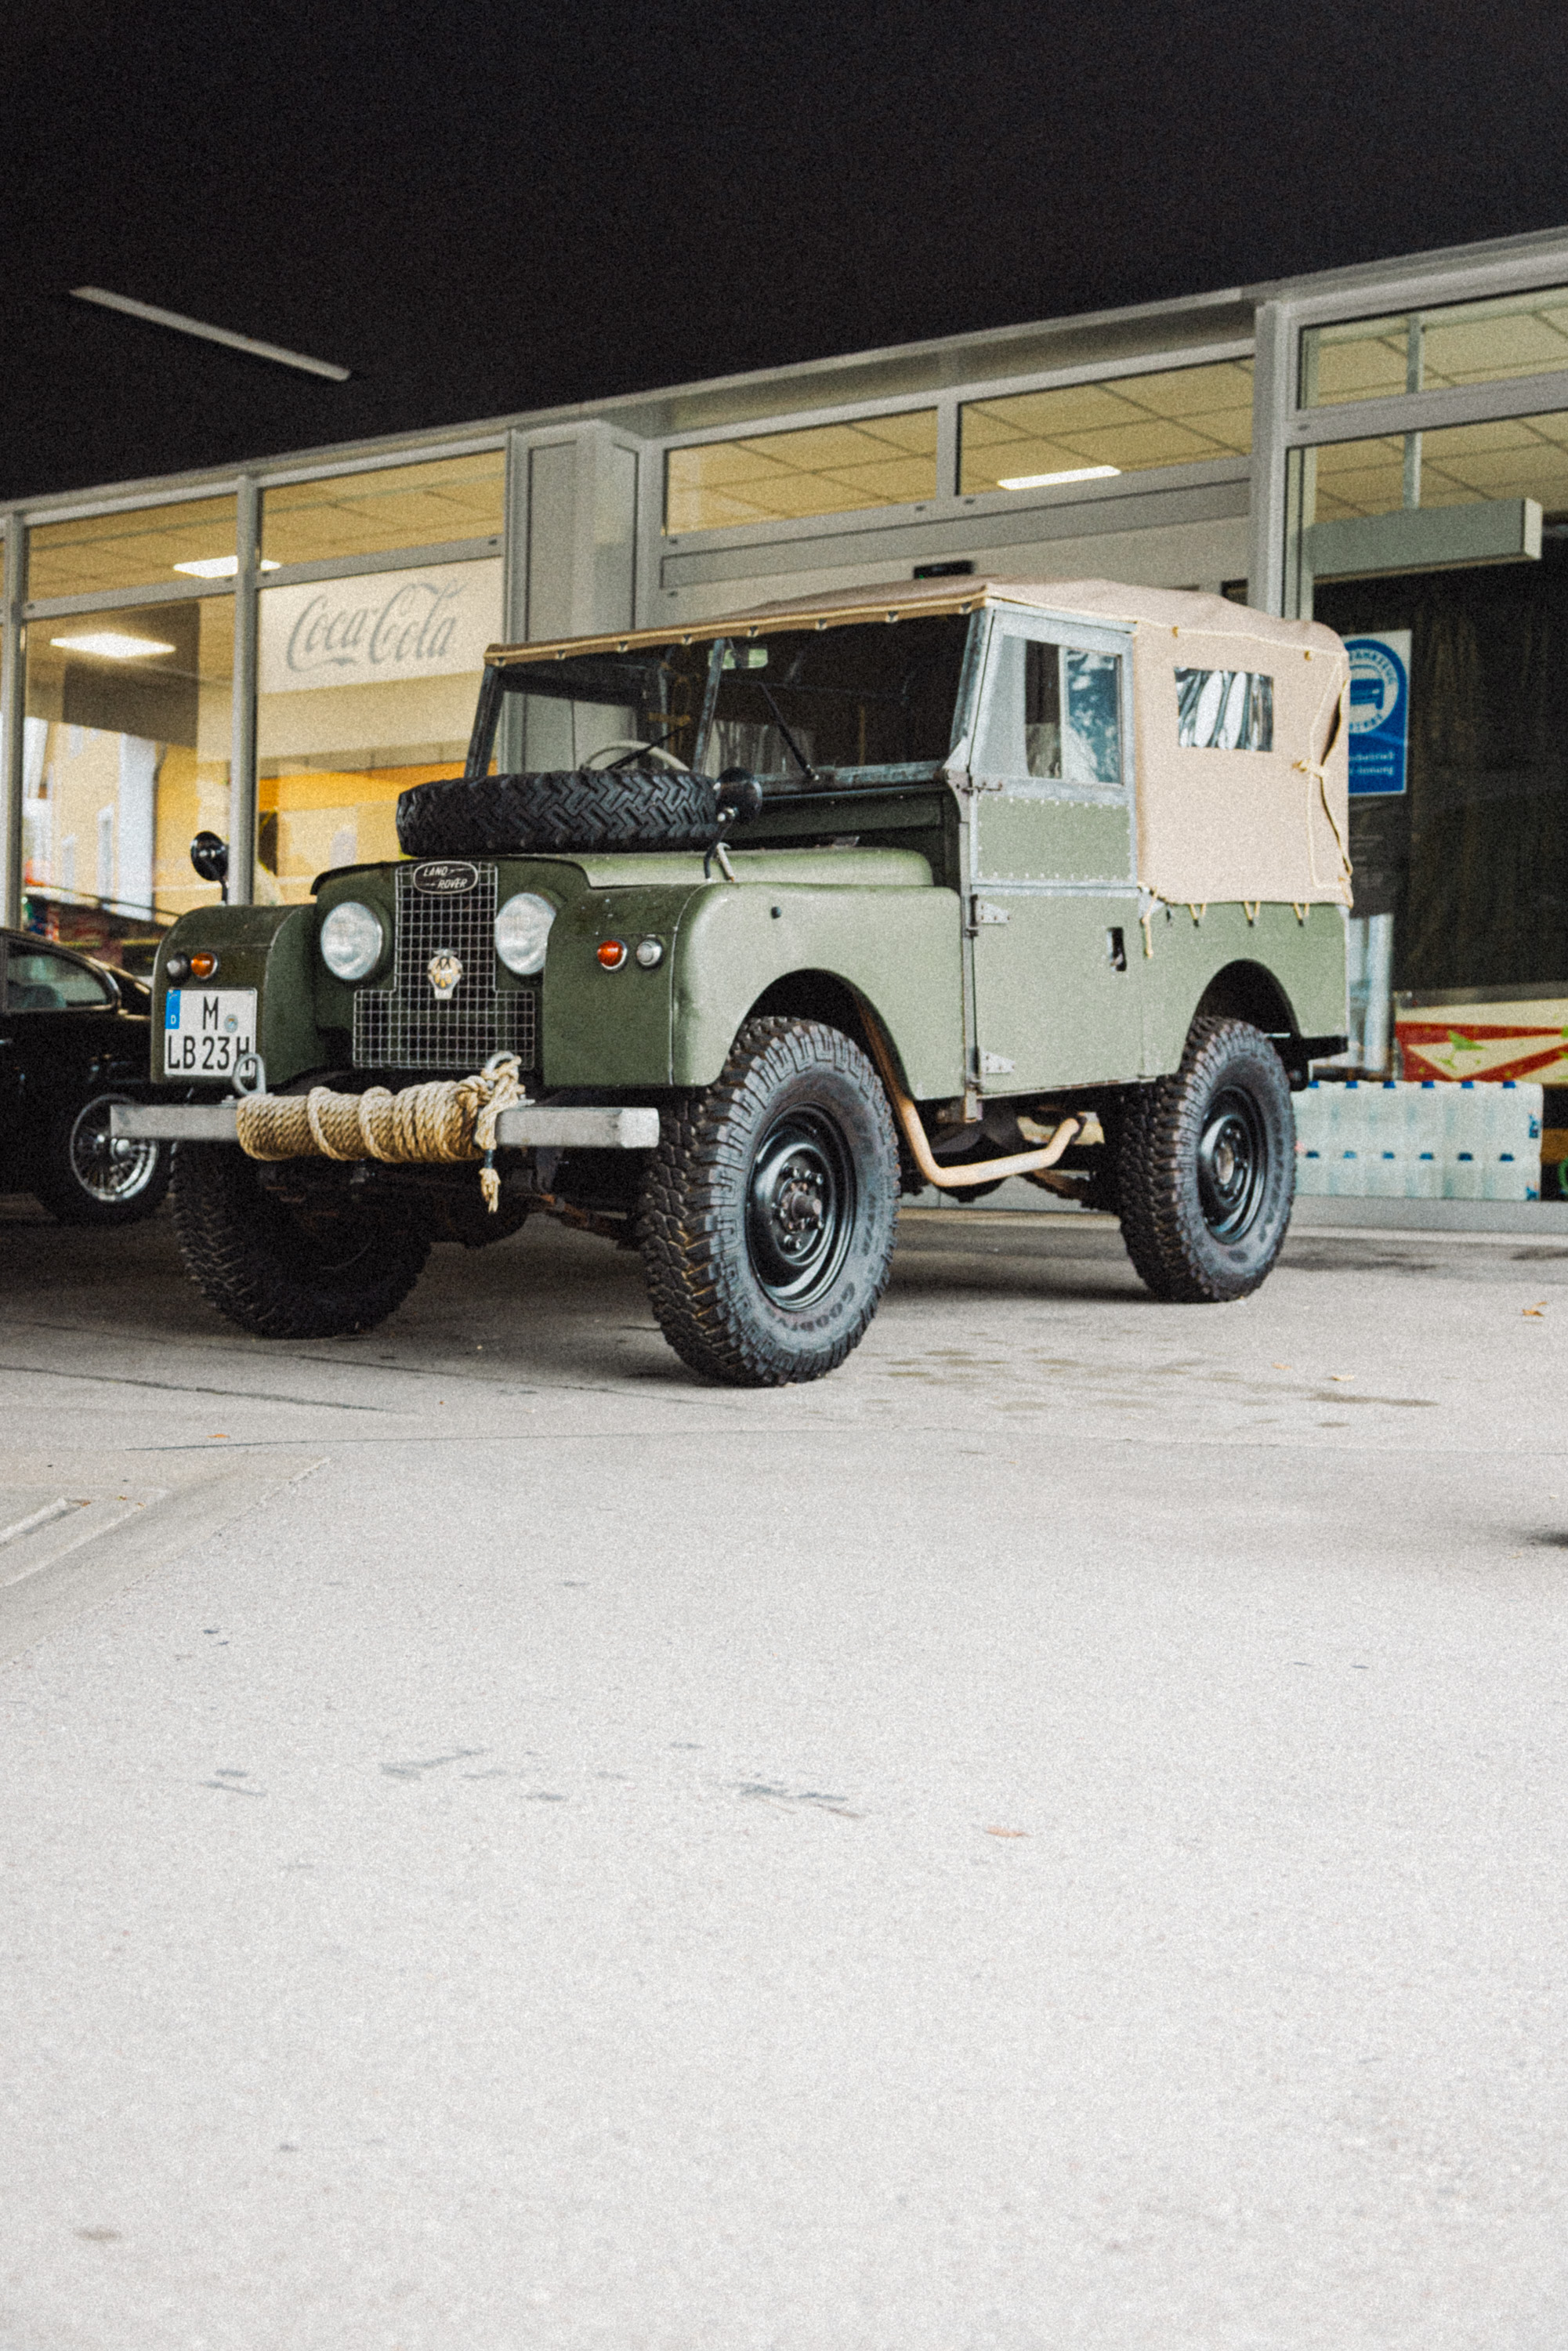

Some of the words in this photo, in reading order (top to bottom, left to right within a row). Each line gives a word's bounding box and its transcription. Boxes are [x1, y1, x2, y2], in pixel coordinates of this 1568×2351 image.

[422, 865, 448, 877] LAND
[437, 877, 468, 890] ROVER
[202, 996, 219, 1031] M
